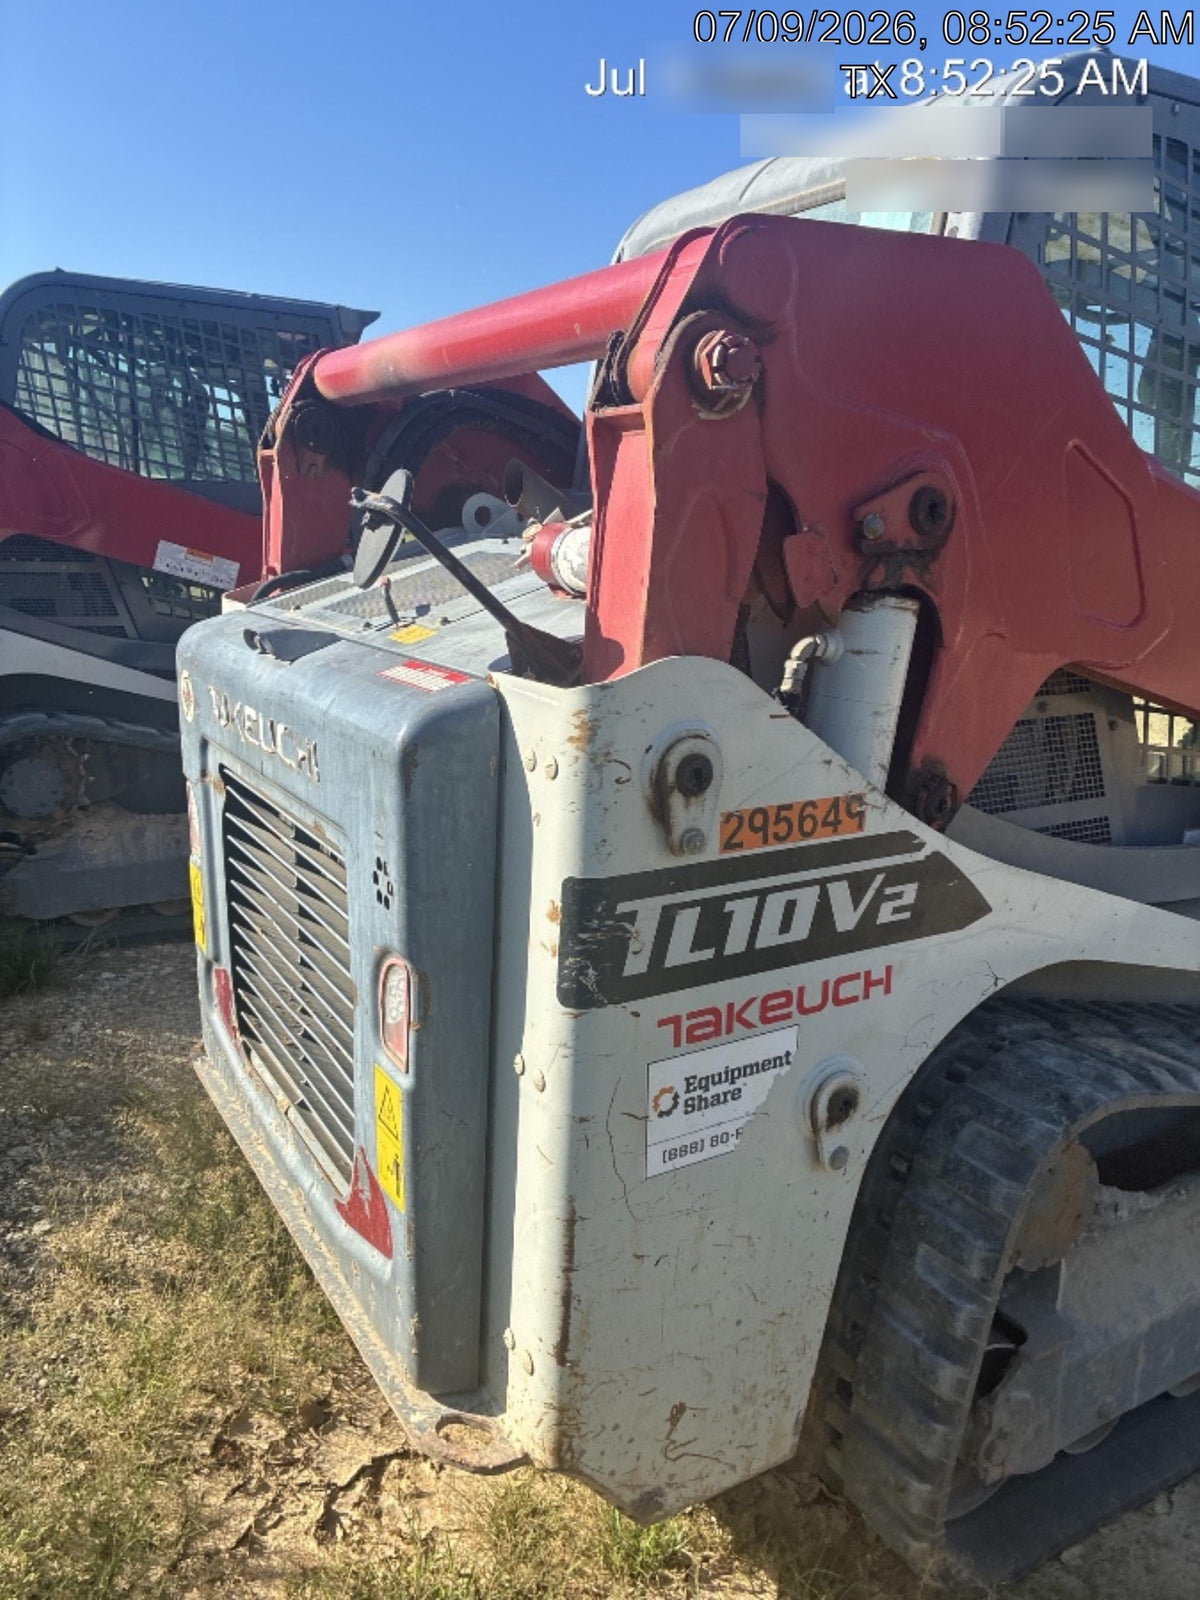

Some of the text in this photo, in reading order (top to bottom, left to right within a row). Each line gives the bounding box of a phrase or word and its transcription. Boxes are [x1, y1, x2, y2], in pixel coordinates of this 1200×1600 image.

[723, 795, 866, 850] 295649
[614, 872, 920, 978] TL10V2
[683, 1050, 793, 1094] Equipment
[683, 1086, 743, 1116] Share
[662, 1138, 706, 1164] (888)
